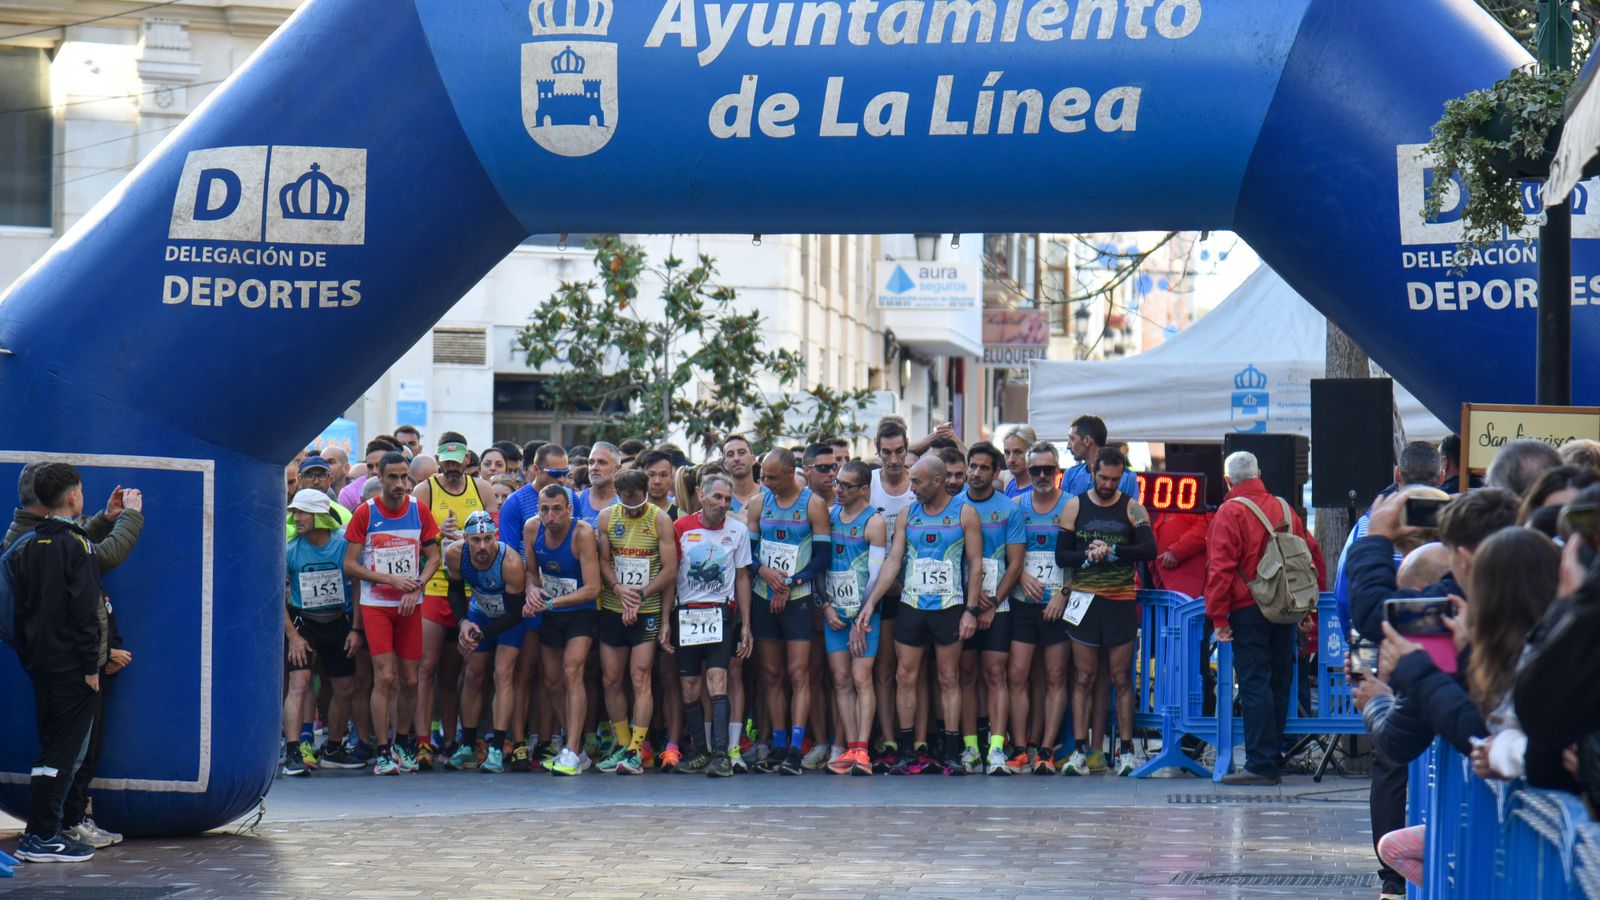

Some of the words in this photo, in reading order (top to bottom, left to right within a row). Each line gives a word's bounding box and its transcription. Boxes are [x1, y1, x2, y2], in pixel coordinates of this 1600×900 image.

[644, 0, 1201, 67] Ayuntamiento
[708, 74, 800, 139] de
[818, 75, 910, 137] La
[928, 71, 1142, 136] Línea
[192, 167, 242, 221] D
[164, 245, 293, 267] DELEGACIÓN
[299, 251, 327, 267] DE
[919, 265, 958, 280] aura
[162, 274, 363, 309] DEPORTES
[919, 281, 968, 295] seguros
[1406, 275, 1600, 311] DEPORES
[387, 559, 411, 575] 183
[767, 555, 790, 571] 156
[620, 571, 644, 586] 122
[922, 570, 948, 585] 155
[1035, 564, 1054, 579] 27
[312, 582, 338, 598] 153
[832, 584, 854, 598] 160
[690, 621, 717, 635] 216
